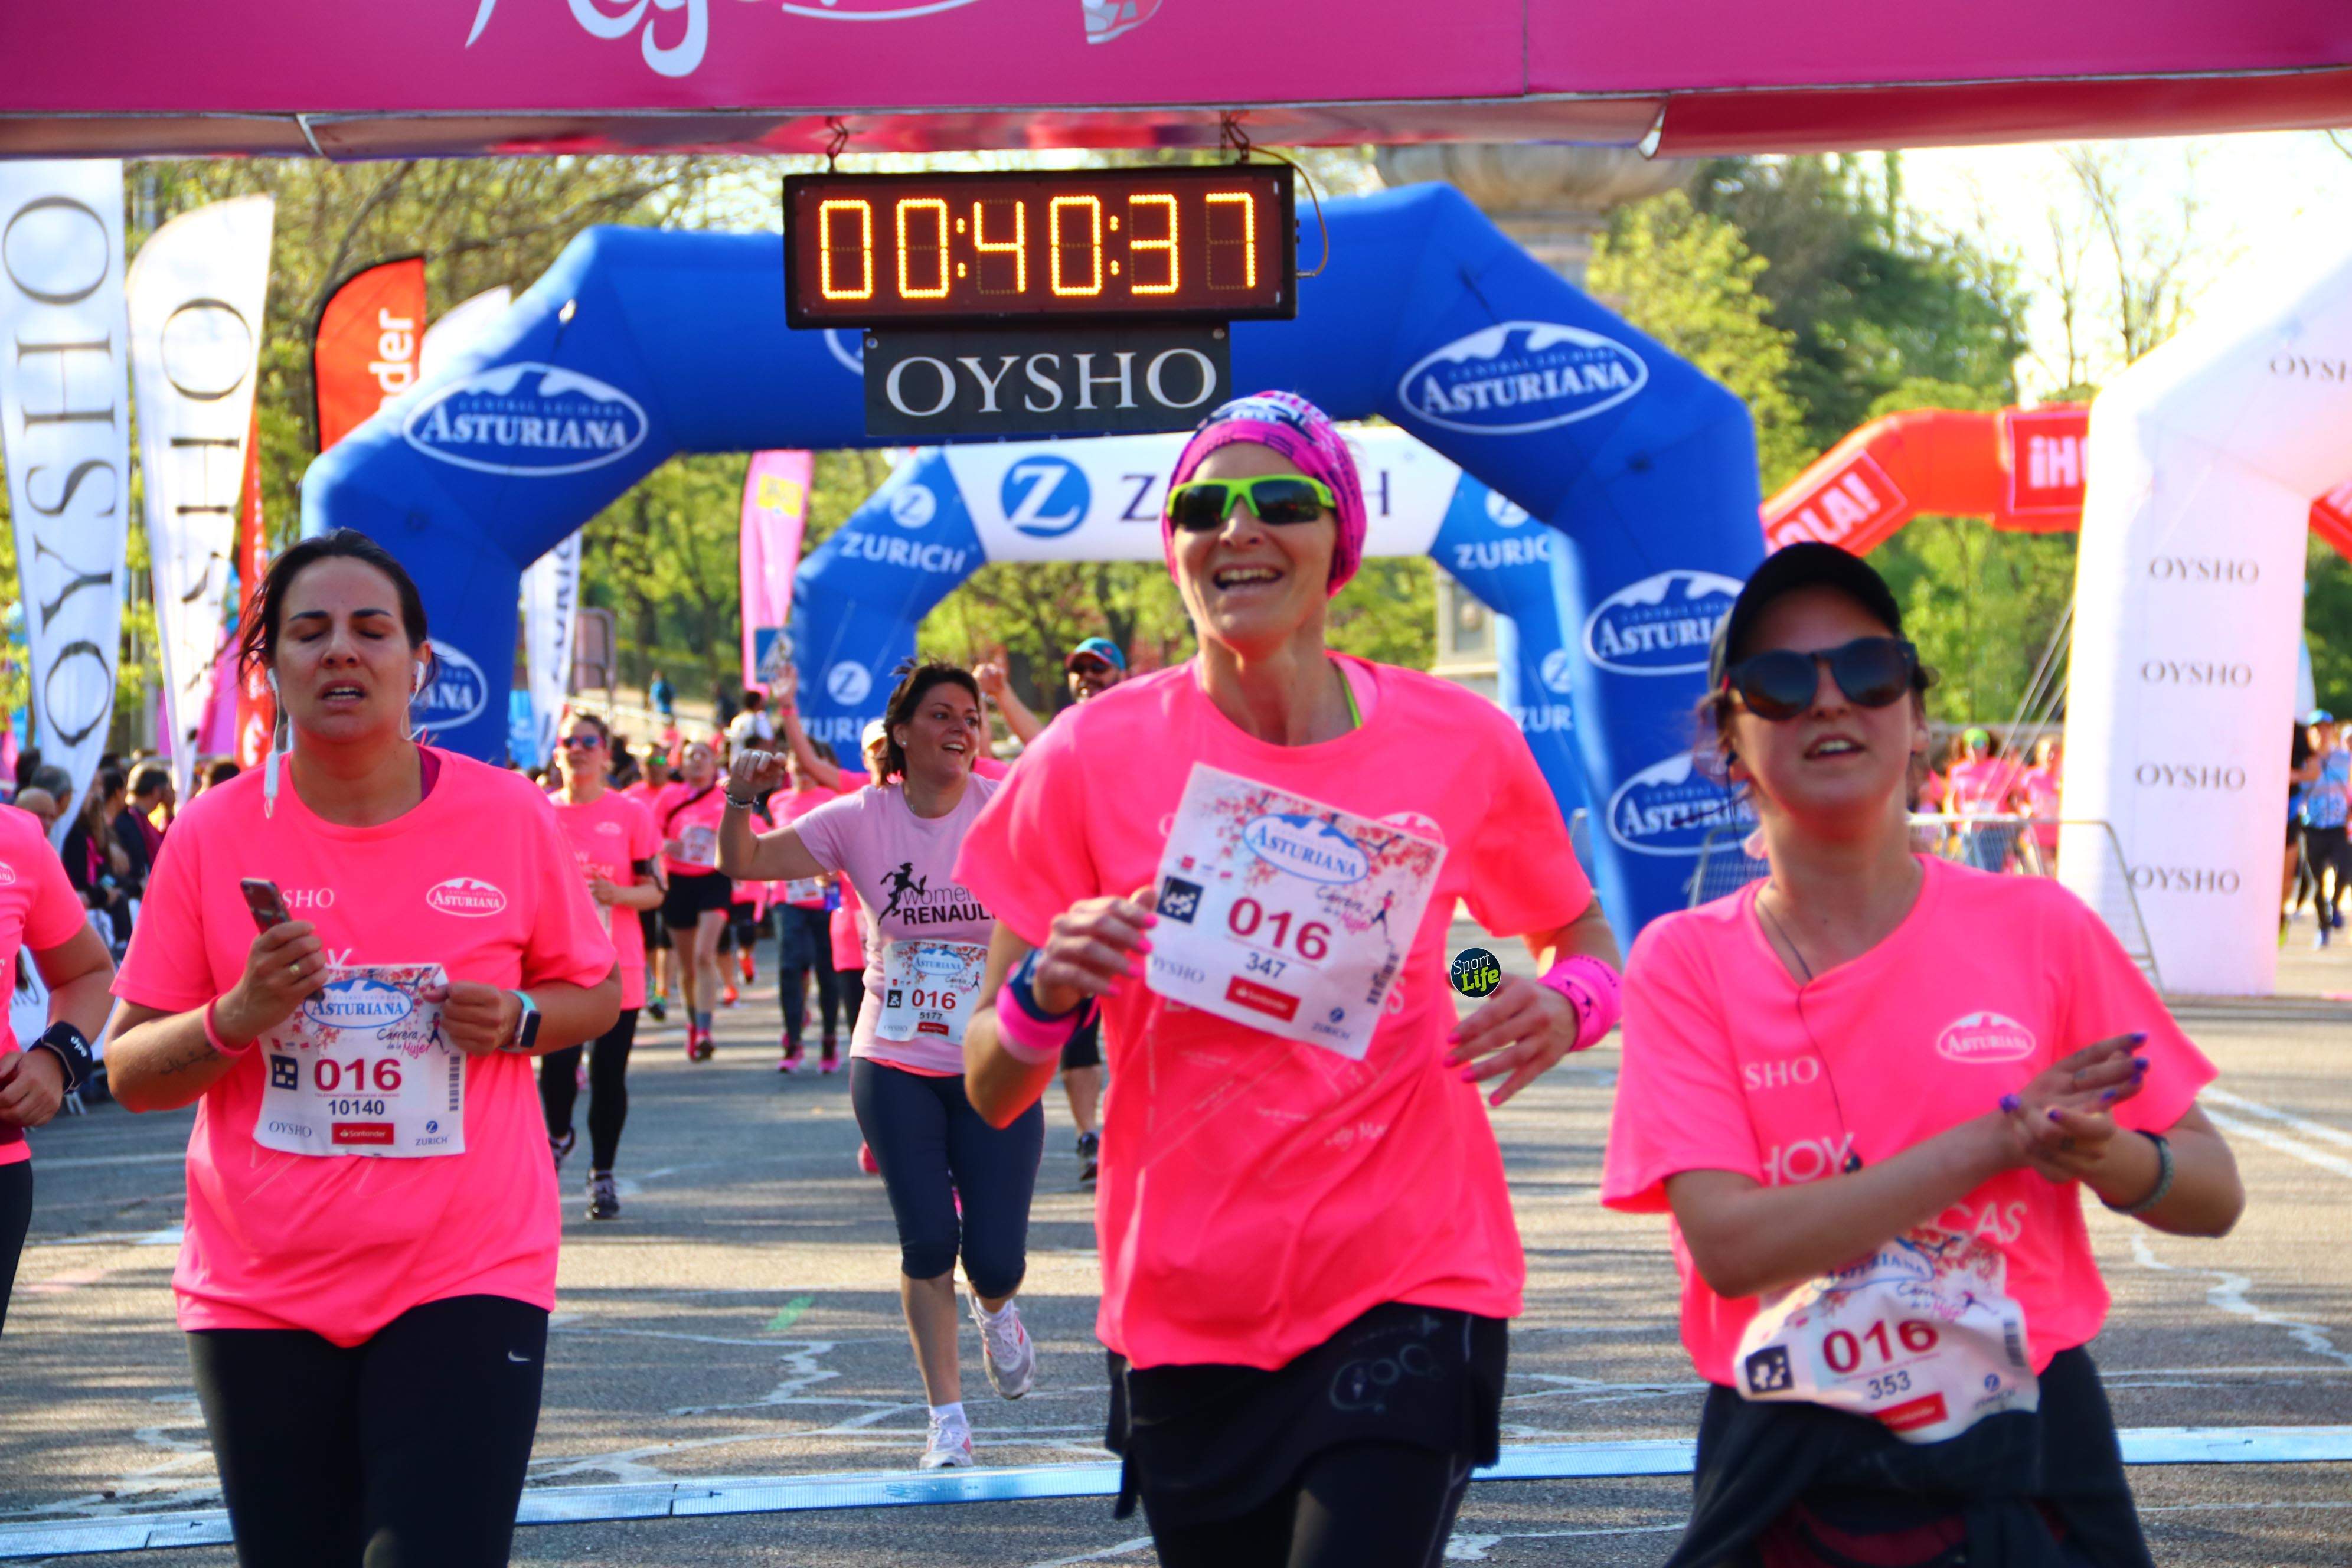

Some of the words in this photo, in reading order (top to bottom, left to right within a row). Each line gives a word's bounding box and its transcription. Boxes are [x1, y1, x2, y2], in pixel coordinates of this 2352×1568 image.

[819, 191, 1256, 299] 00:40:37
[886, 347, 1218, 417] OYSHO
[1422, 360, 1633, 413] ASTURIANA
[420, 400, 628, 449] ASTURIANA
[2, 195, 117, 747] OYSHO
[838, 534, 966, 574] ZURICH
[2149, 556, 2260, 584] OYSHO
[2140, 659, 2252, 688] OYSHO
[2134, 763, 2246, 792] OYSHO
[1251, 824, 1357, 878] ASTURIANA
[2128, 865, 2240, 894] OYSHO
[433, 890, 501, 909] ASTURIANA
[903, 903, 997, 926] RENAUL
[1227, 897, 1332, 961] 016
[915, 957, 962, 971] ASTURIANA
[1245, 952, 1288, 979] 347
[311, 1001, 404, 1016] ASTURIANA
[912, 989, 956, 1010] 016
[919, 1012, 943, 1020] 5177
[377, 1028, 419, 1041] Carrera
[401, 1042, 432, 1059] Mujer
[313, 1057, 402, 1092] 016
[328, 1100, 384, 1115] 10140
[269, 1121, 312, 1138] OYSHO
[349, 1129, 386, 1138] Santander
[415, 1137, 449, 1146] ZURICH
[1822, 1317, 1939, 1374] 016
[1868, 1370, 1912, 1400] 353
